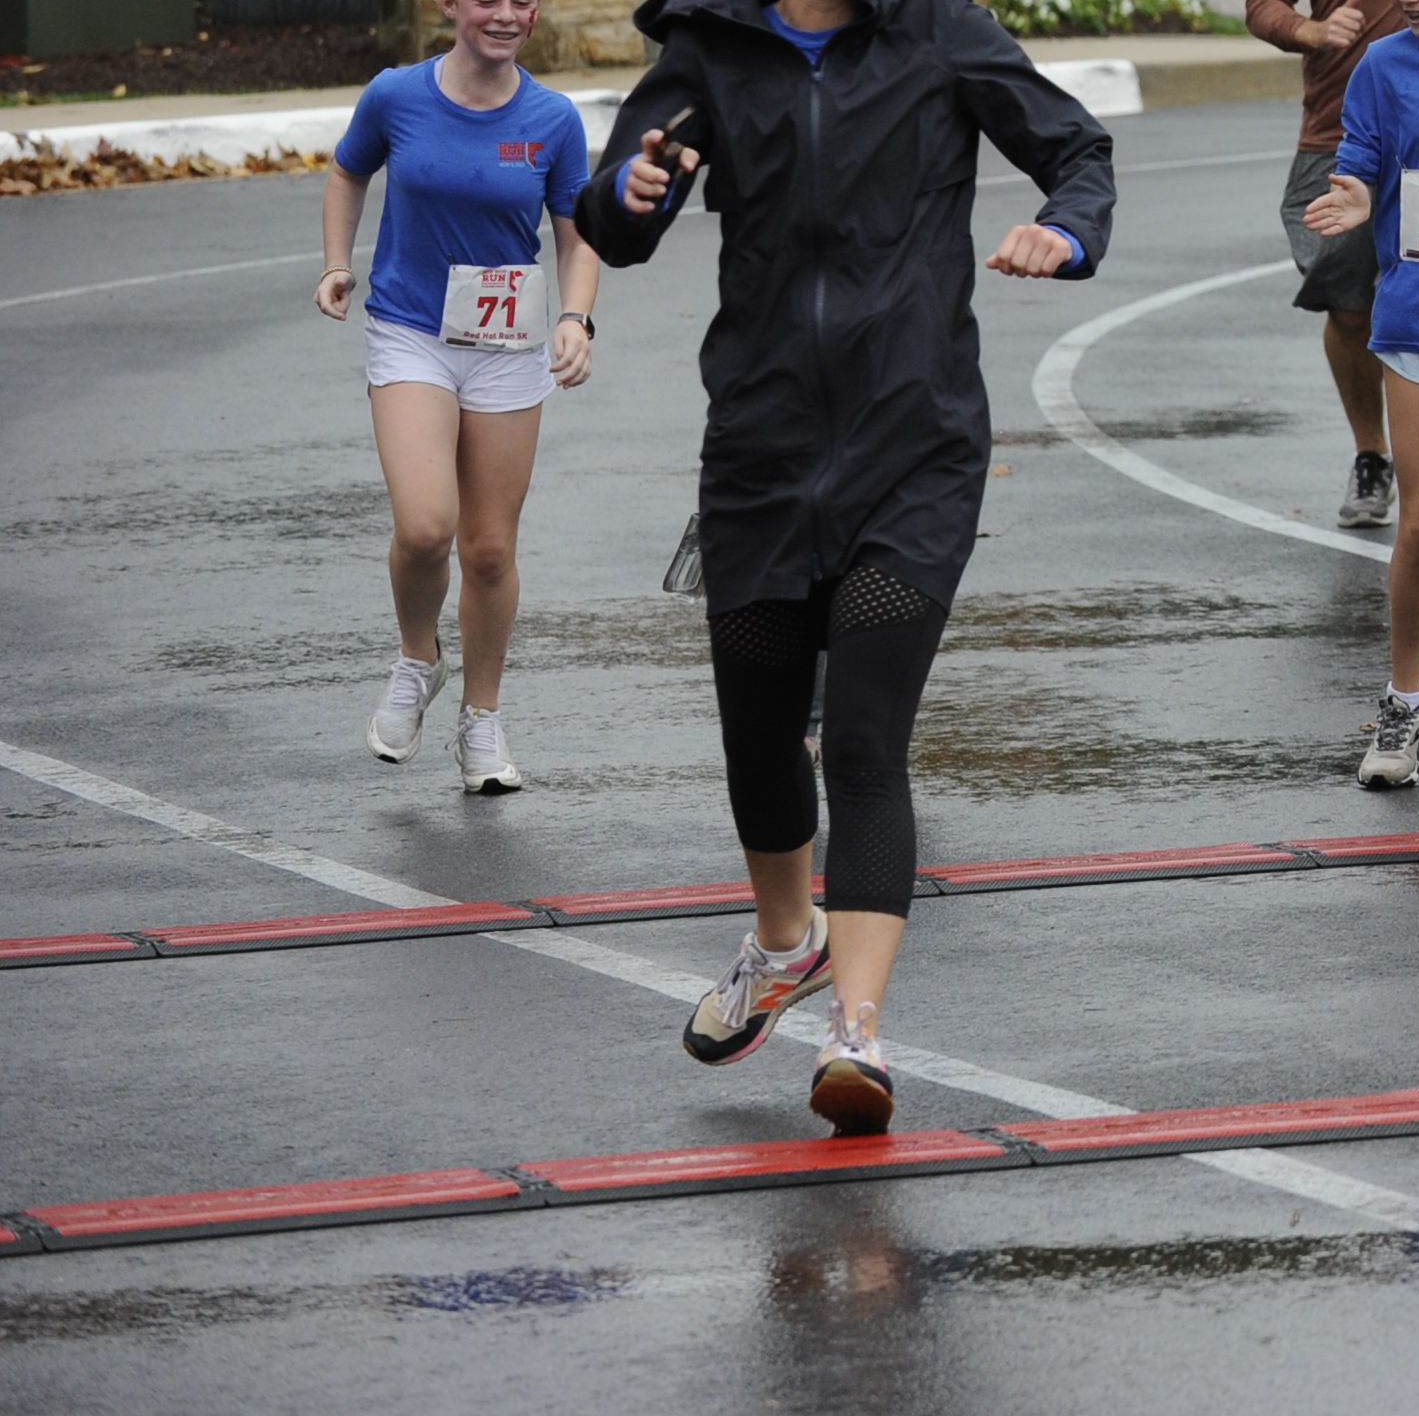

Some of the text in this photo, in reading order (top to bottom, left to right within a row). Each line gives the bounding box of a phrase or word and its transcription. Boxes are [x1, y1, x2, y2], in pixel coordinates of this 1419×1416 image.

[482, 274, 507, 282] RUN
[477, 296, 516, 328] 71
[463, 331, 480, 340] Red
[498, 332, 515, 340] Run
[517, 332, 528, 340] 5K
